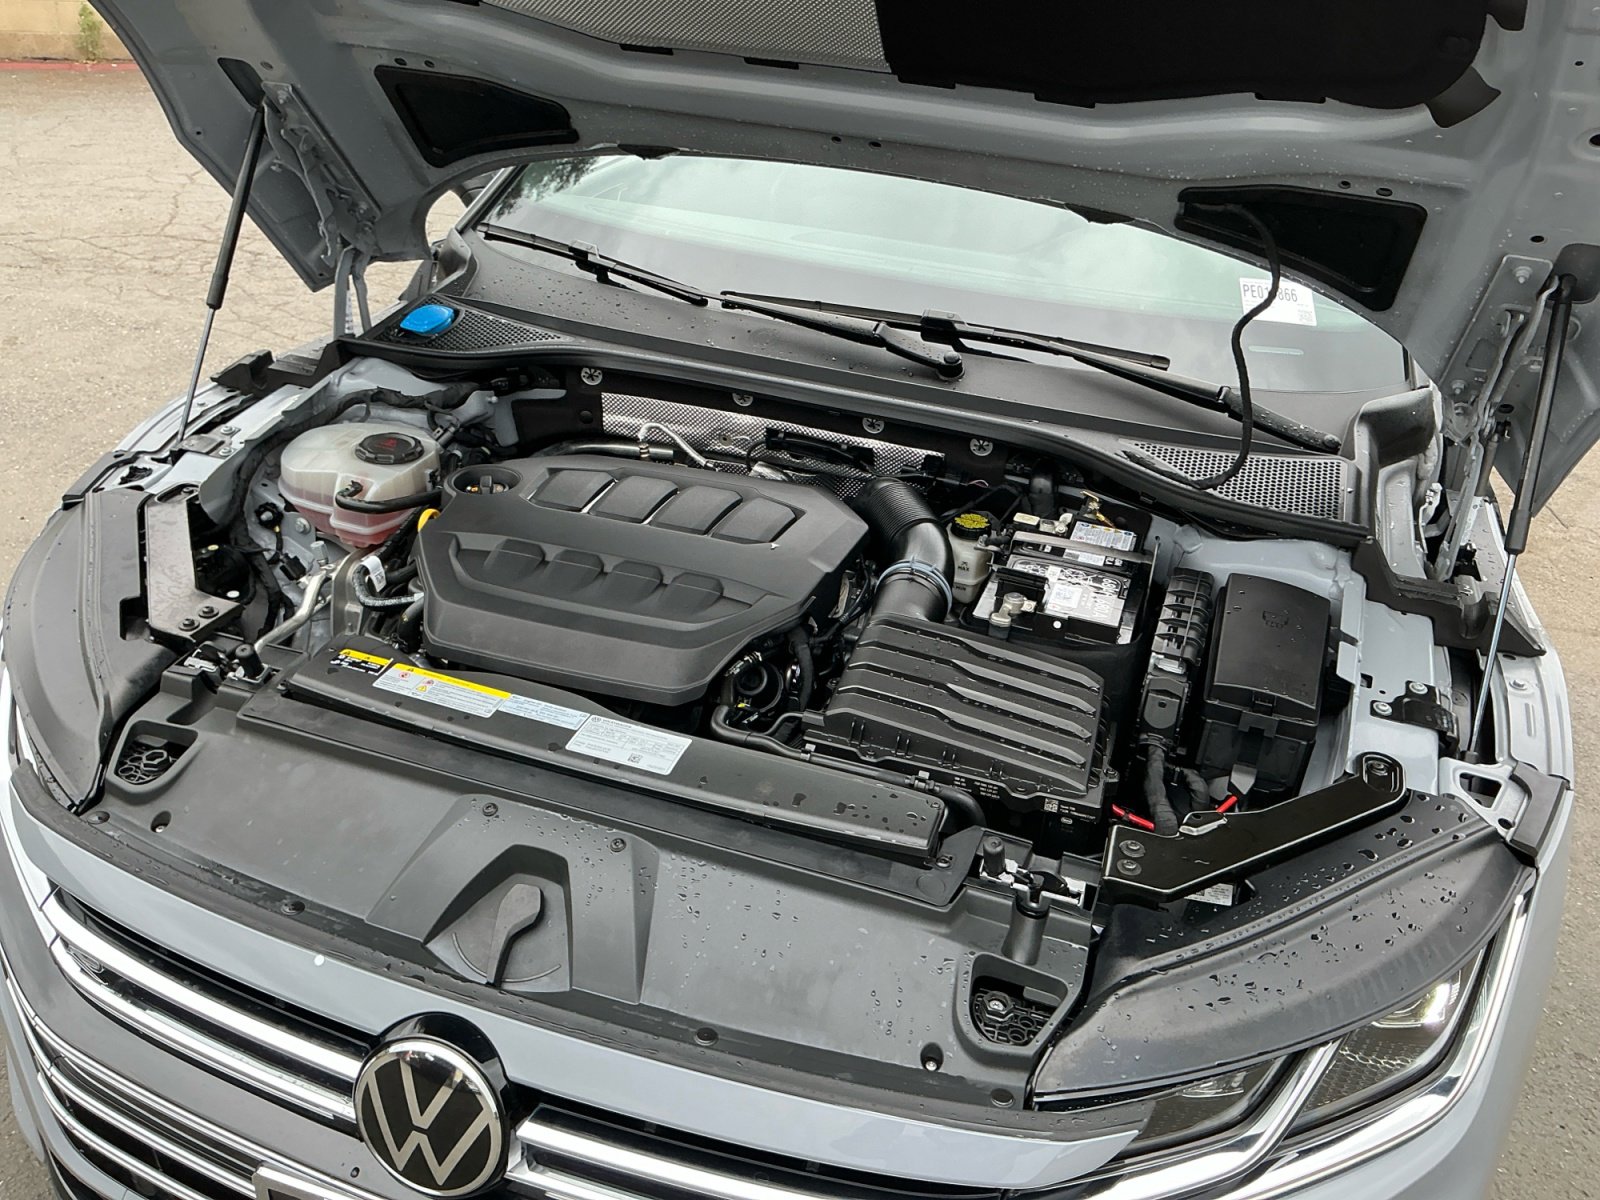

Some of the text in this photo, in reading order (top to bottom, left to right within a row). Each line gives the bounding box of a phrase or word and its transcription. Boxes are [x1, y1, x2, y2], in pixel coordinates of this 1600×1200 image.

[1243, 284, 1297, 302] PE01866
[957, 565, 970, 573] MAX
[362, 1045, 496, 1189] VW
